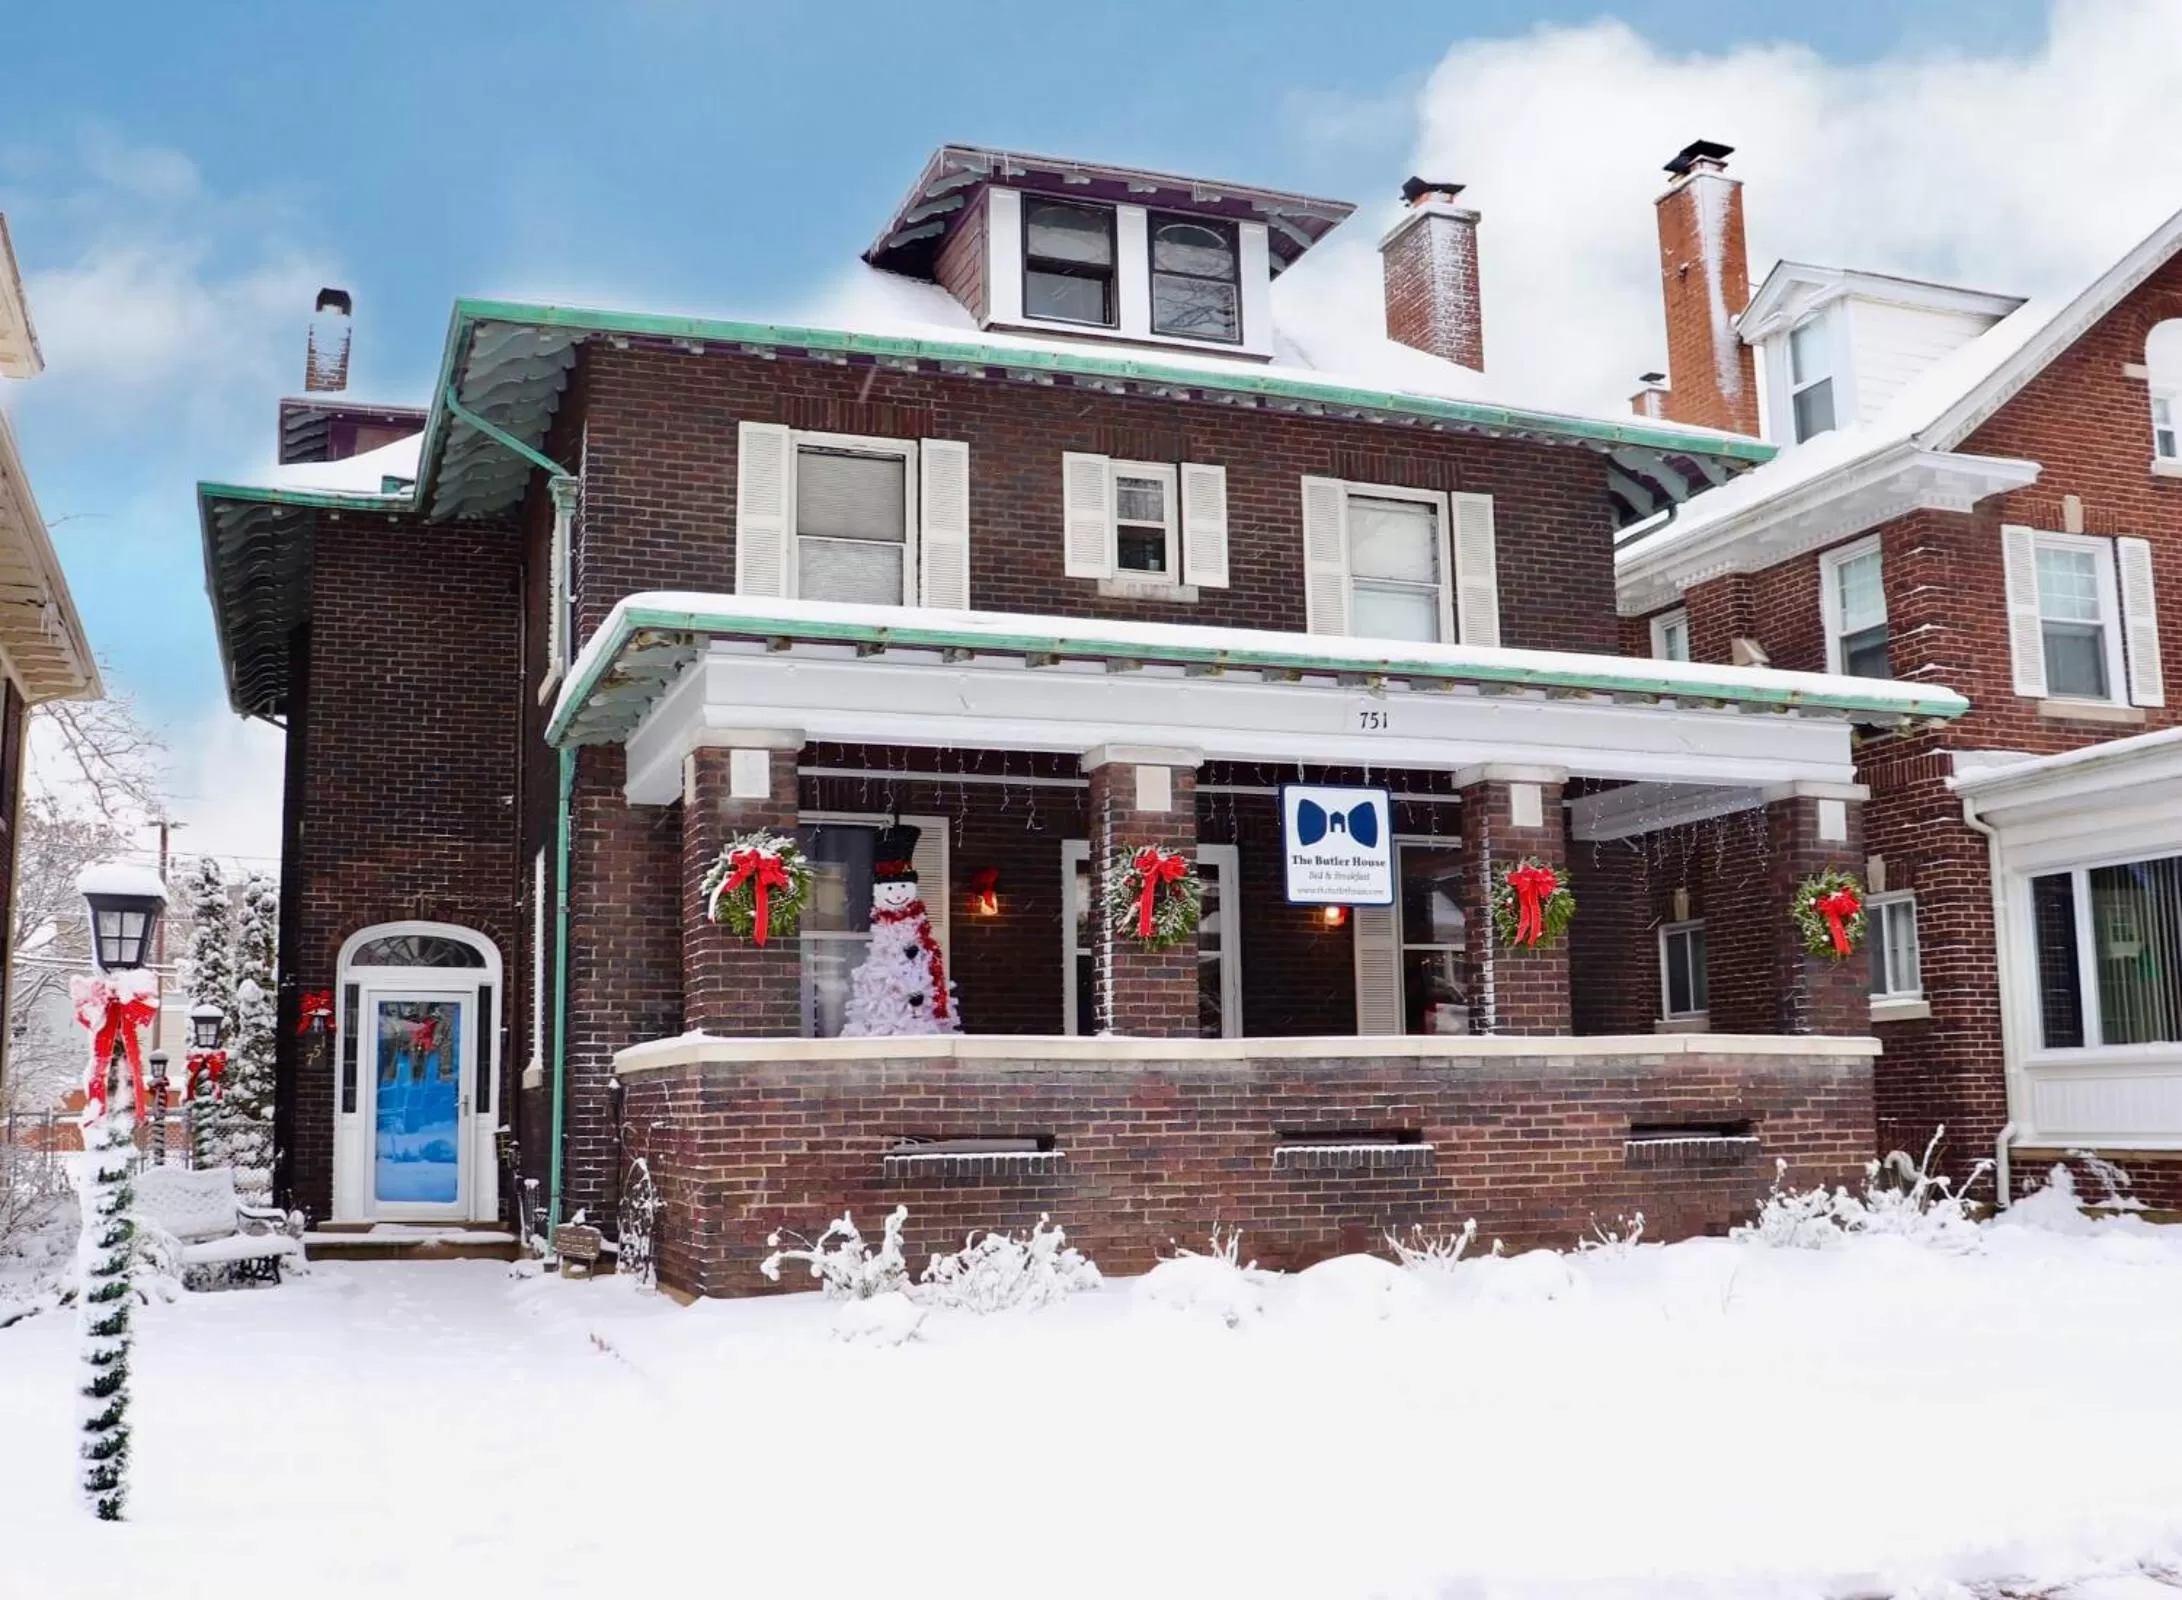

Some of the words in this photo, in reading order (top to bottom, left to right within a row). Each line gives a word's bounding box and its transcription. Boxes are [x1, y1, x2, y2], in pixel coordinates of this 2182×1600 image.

[1360, 711, 1387, 729] 751
[1292, 855, 1312, 865] The
[1315, 855, 1350, 866] Butler
[1352, 856, 1385, 867] House
[306, 1035, 325, 1066] 751
